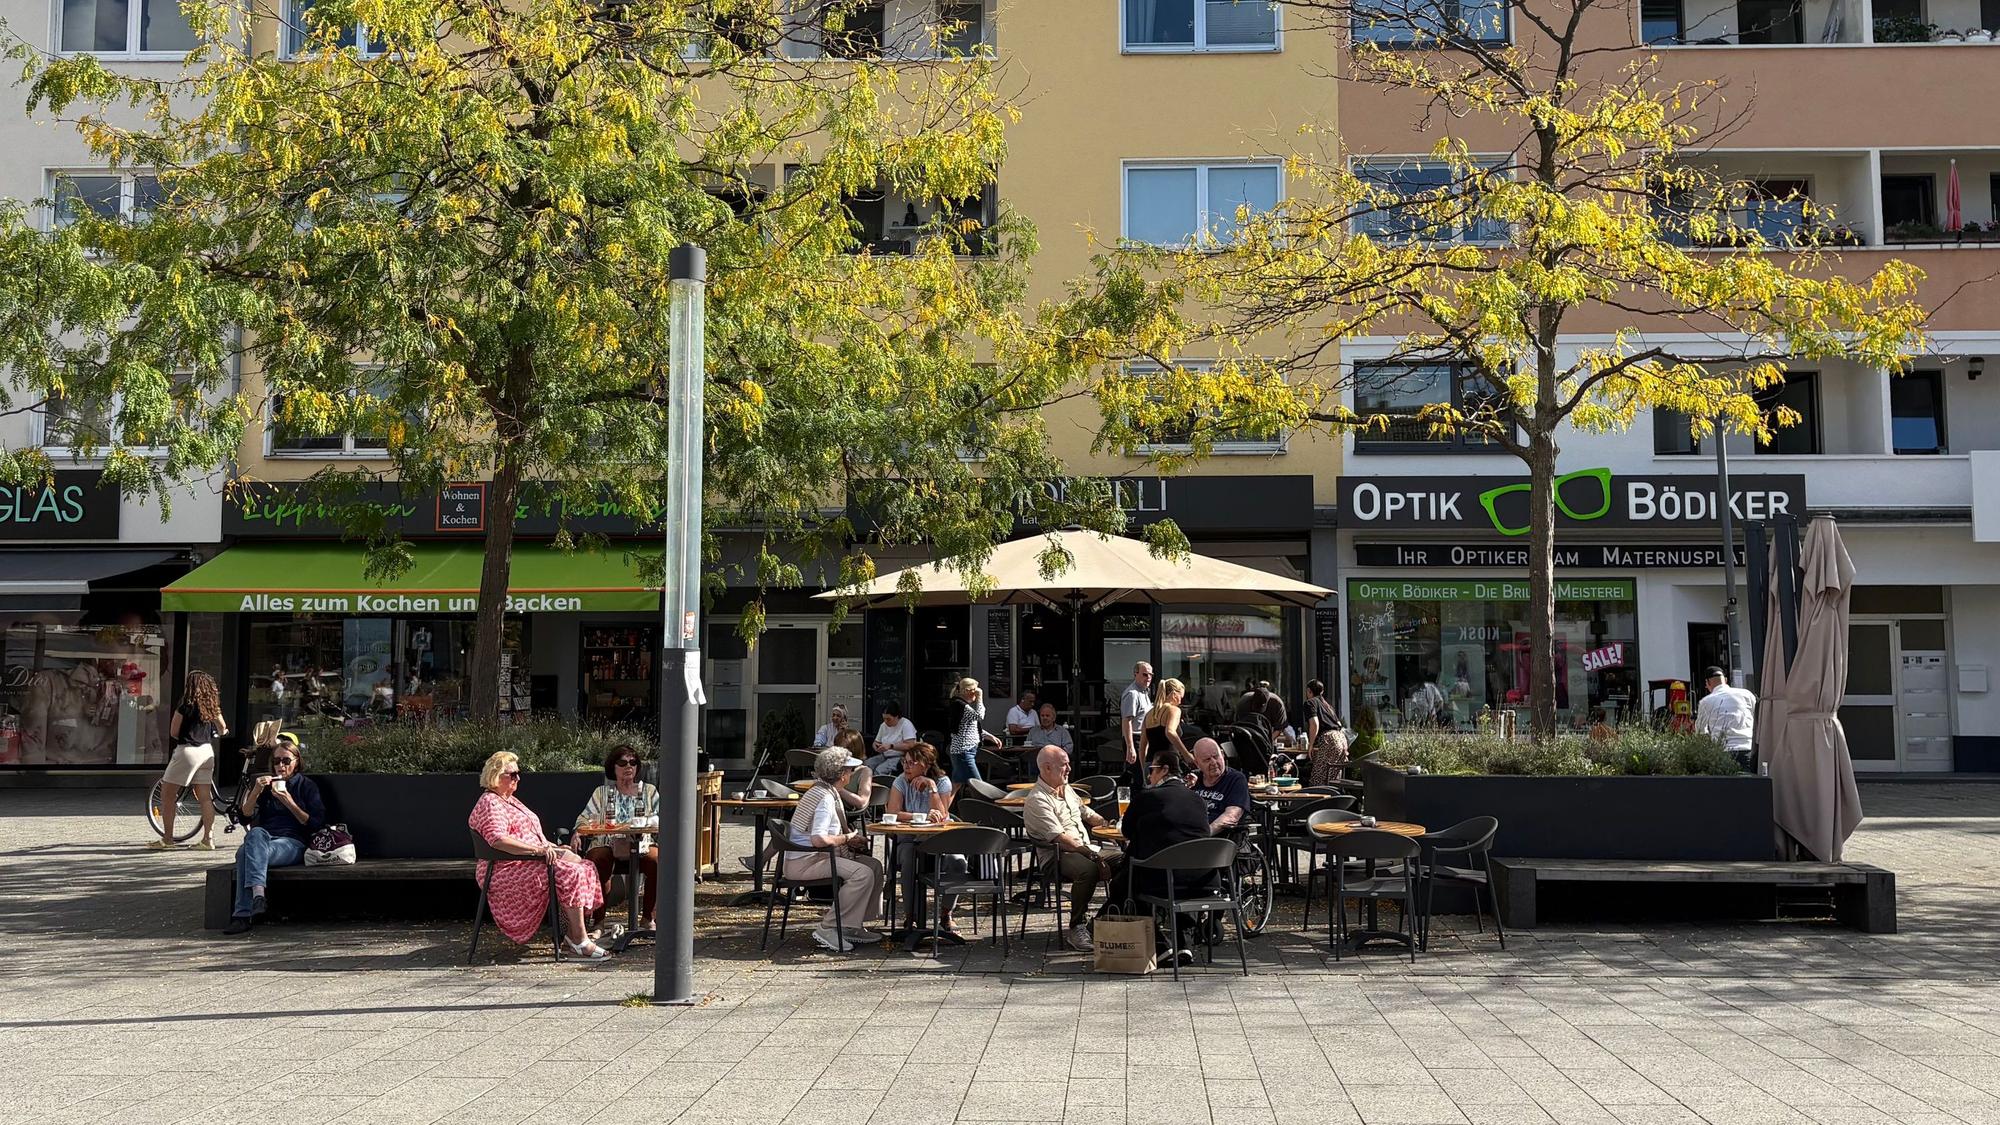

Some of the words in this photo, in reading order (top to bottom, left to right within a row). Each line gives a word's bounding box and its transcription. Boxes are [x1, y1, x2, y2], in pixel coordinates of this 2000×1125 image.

[442, 491, 480, 500] Wohnen
[1352, 483, 1463, 521] OPTIK
[1628, 482, 1790, 521] BÖDIKER
[456, 503, 465, 513] &
[442, 515, 478, 525] Kochen
[1397, 546, 1428, 565] IHR
[1451, 546, 1529, 565] OPTIKER
[1553, 551, 1579, 566] AM
[1359, 584, 1398, 599] OPTIK
[1402, 583, 1458, 599] BÖDIKER
[1475, 584, 1498, 599] DIE
[240, 595, 294, 611] Alles
[302, 599, 349, 611] zum
[357, 595, 440, 611] Kochen
[448, 598, 477, 611] un
[1582, 643, 1623, 672] SALE!
